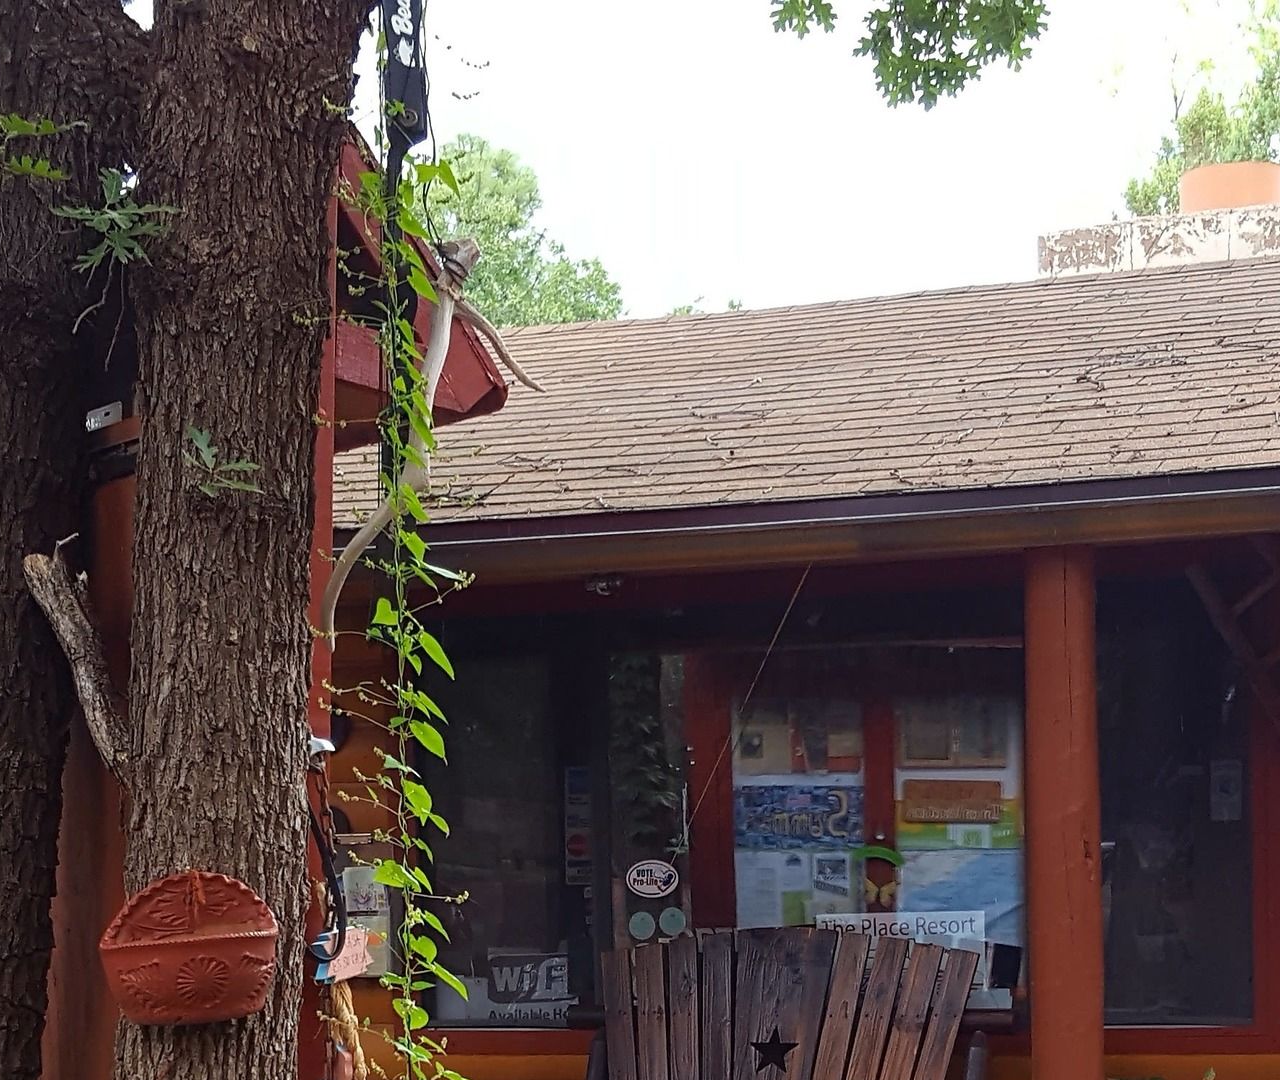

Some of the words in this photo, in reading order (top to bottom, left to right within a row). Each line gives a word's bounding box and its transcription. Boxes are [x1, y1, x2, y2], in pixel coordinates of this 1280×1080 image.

[636, 869, 653, 878] VOTE
[632, 878, 659, 887] Pro-Life
[821, 919, 856, 933] The
[861, 917, 910, 937] Place
[915, 916, 976, 936] Resort
